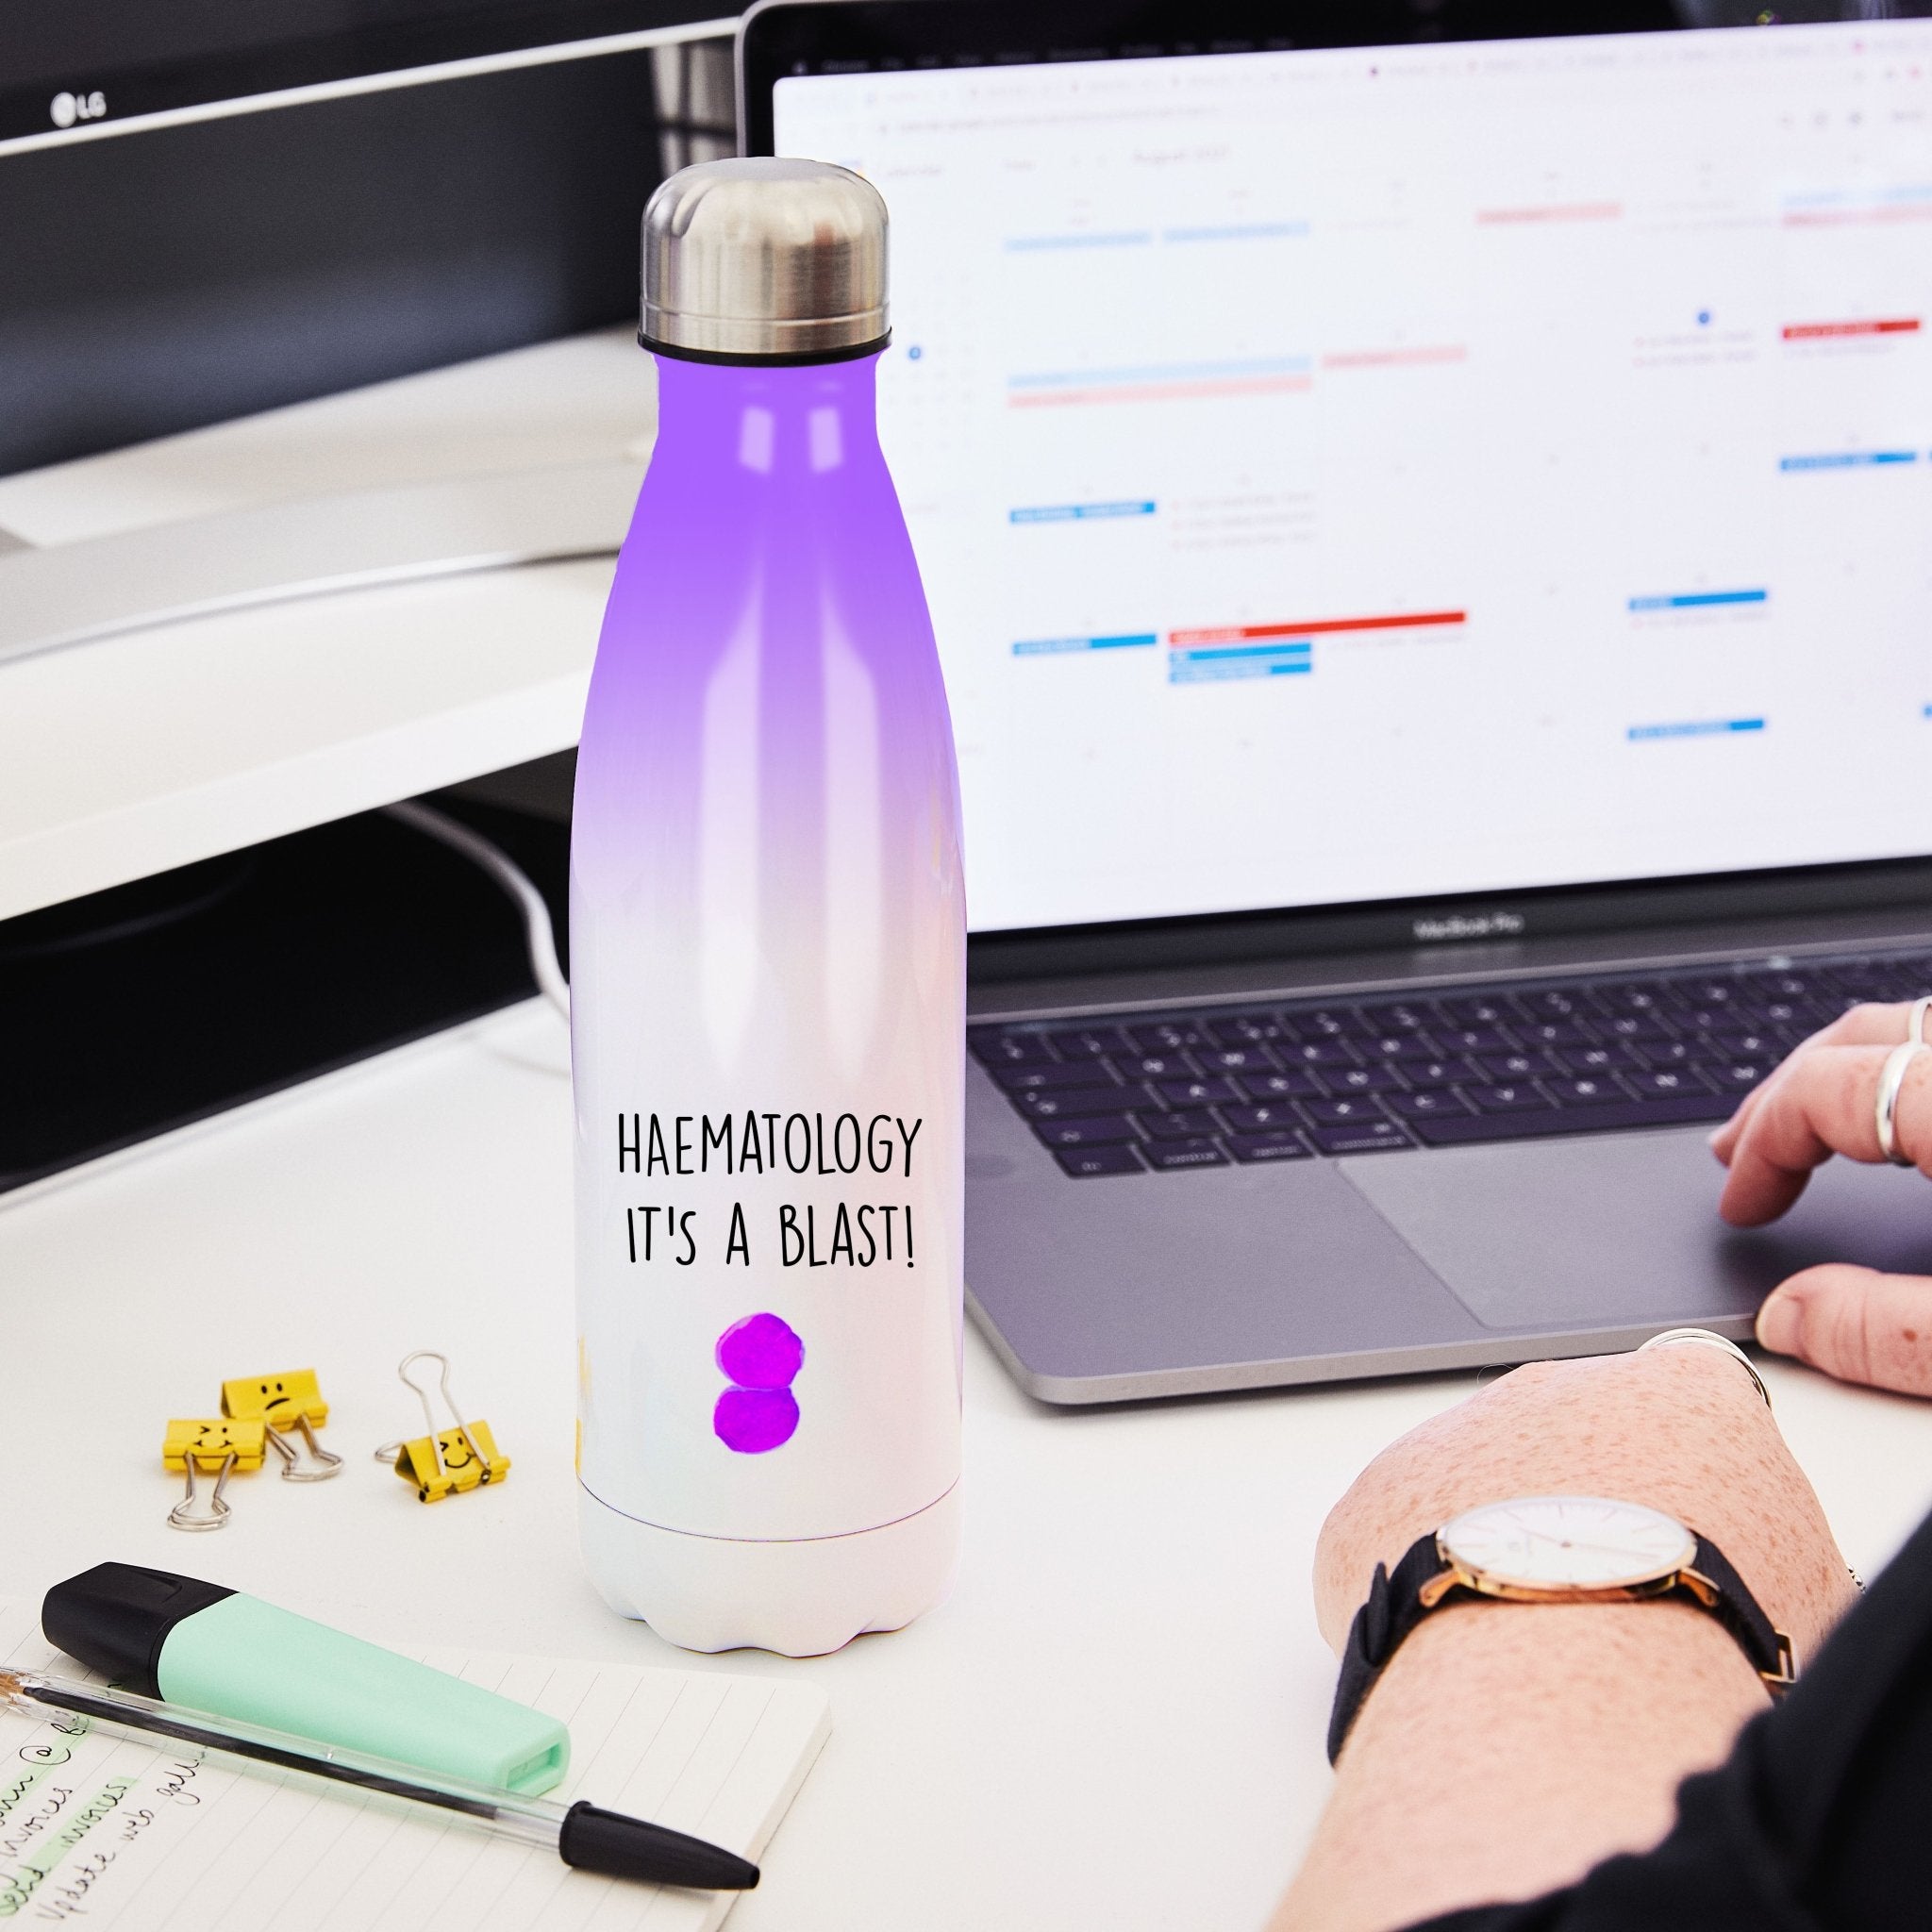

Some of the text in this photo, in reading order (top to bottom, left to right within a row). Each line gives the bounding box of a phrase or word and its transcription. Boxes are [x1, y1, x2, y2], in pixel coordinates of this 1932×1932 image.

[618, 1109, 923, 1178] HAEMATOLOGY
[627, 1202, 915, 1269] IT'S A BLAST!
[120, 1808, 155, 1841] web
